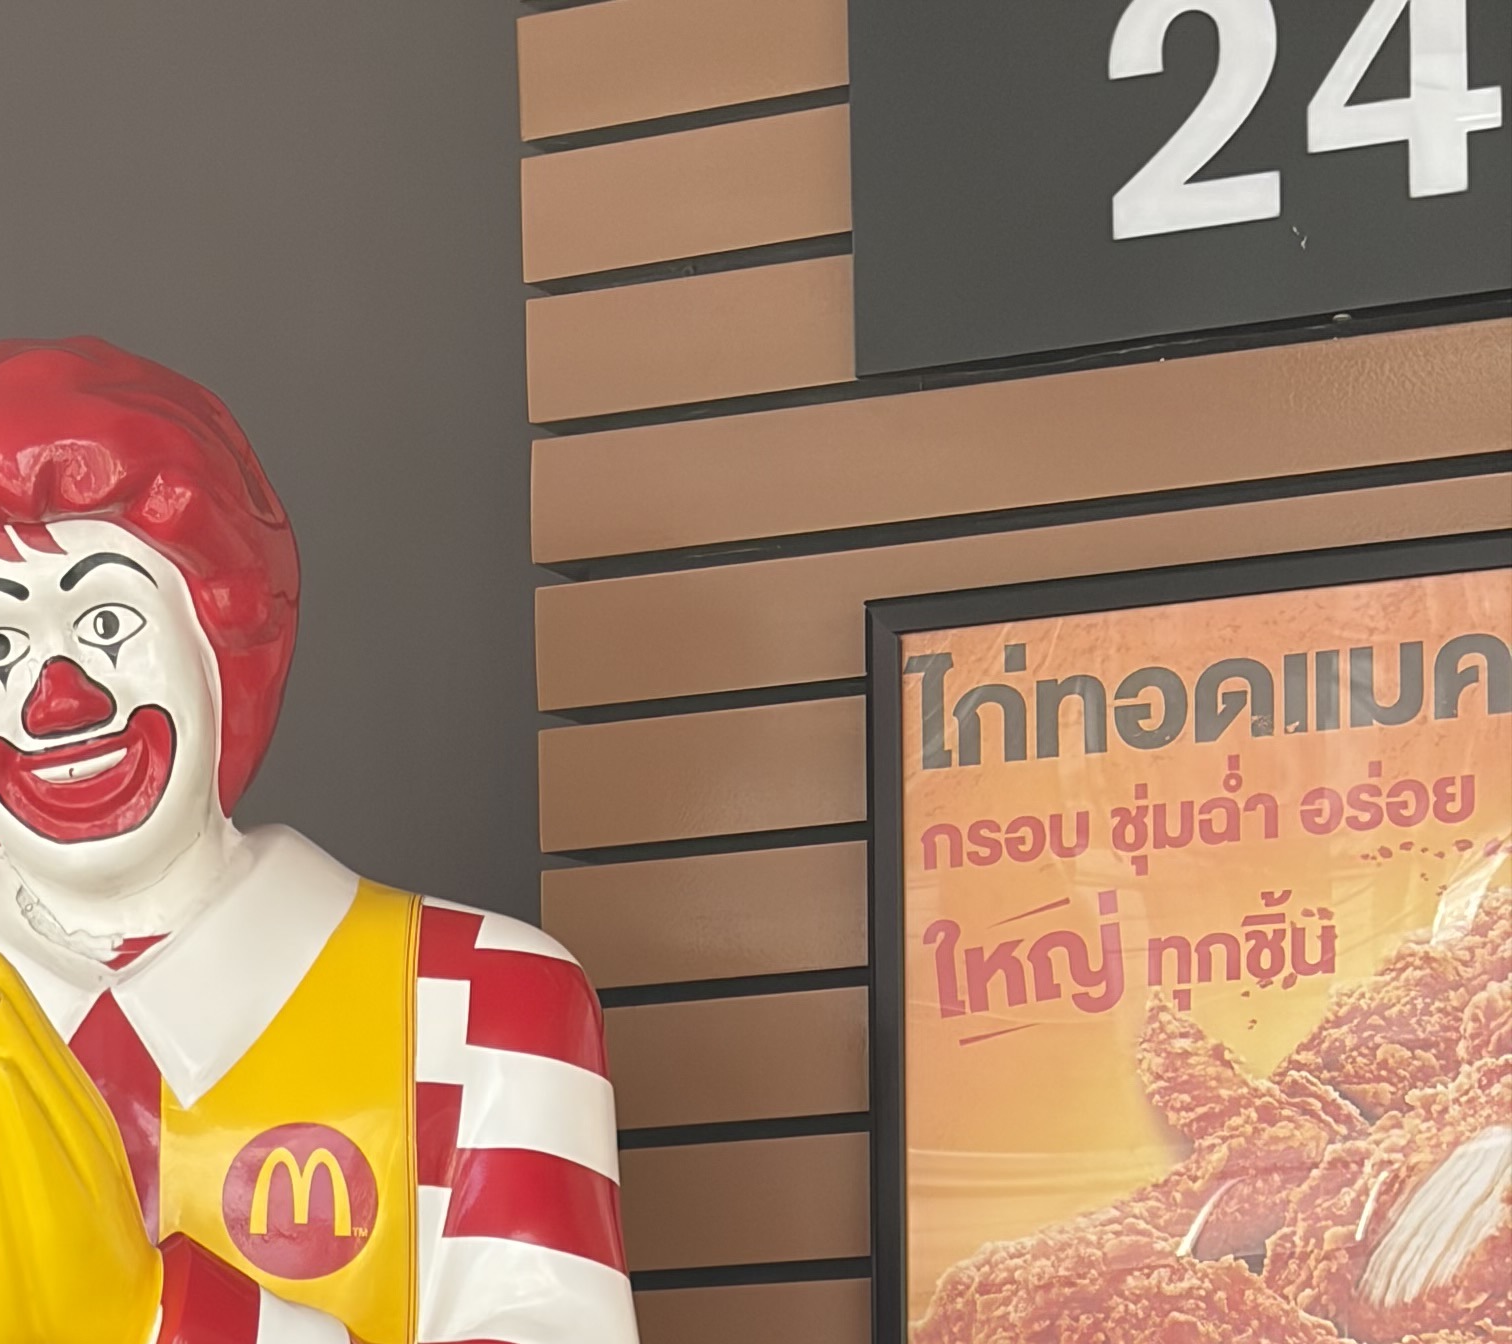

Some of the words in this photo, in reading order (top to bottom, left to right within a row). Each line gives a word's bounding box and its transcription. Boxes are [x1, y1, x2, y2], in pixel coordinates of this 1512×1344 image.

[1108, 0, 1502, 240] 24
[902, 633, 1512, 771] ไก่ทอดแมค
[920, 810, 1090, 871] กรอบ
[1109, 753, 1280, 877] ชุ่มฉ่ำ
[1299, 760, 1476, 836] อร่อย
[921, 889, 1126, 1019] ใหญ่
[1146, 889, 1338, 1012] ทุกชิ้น
